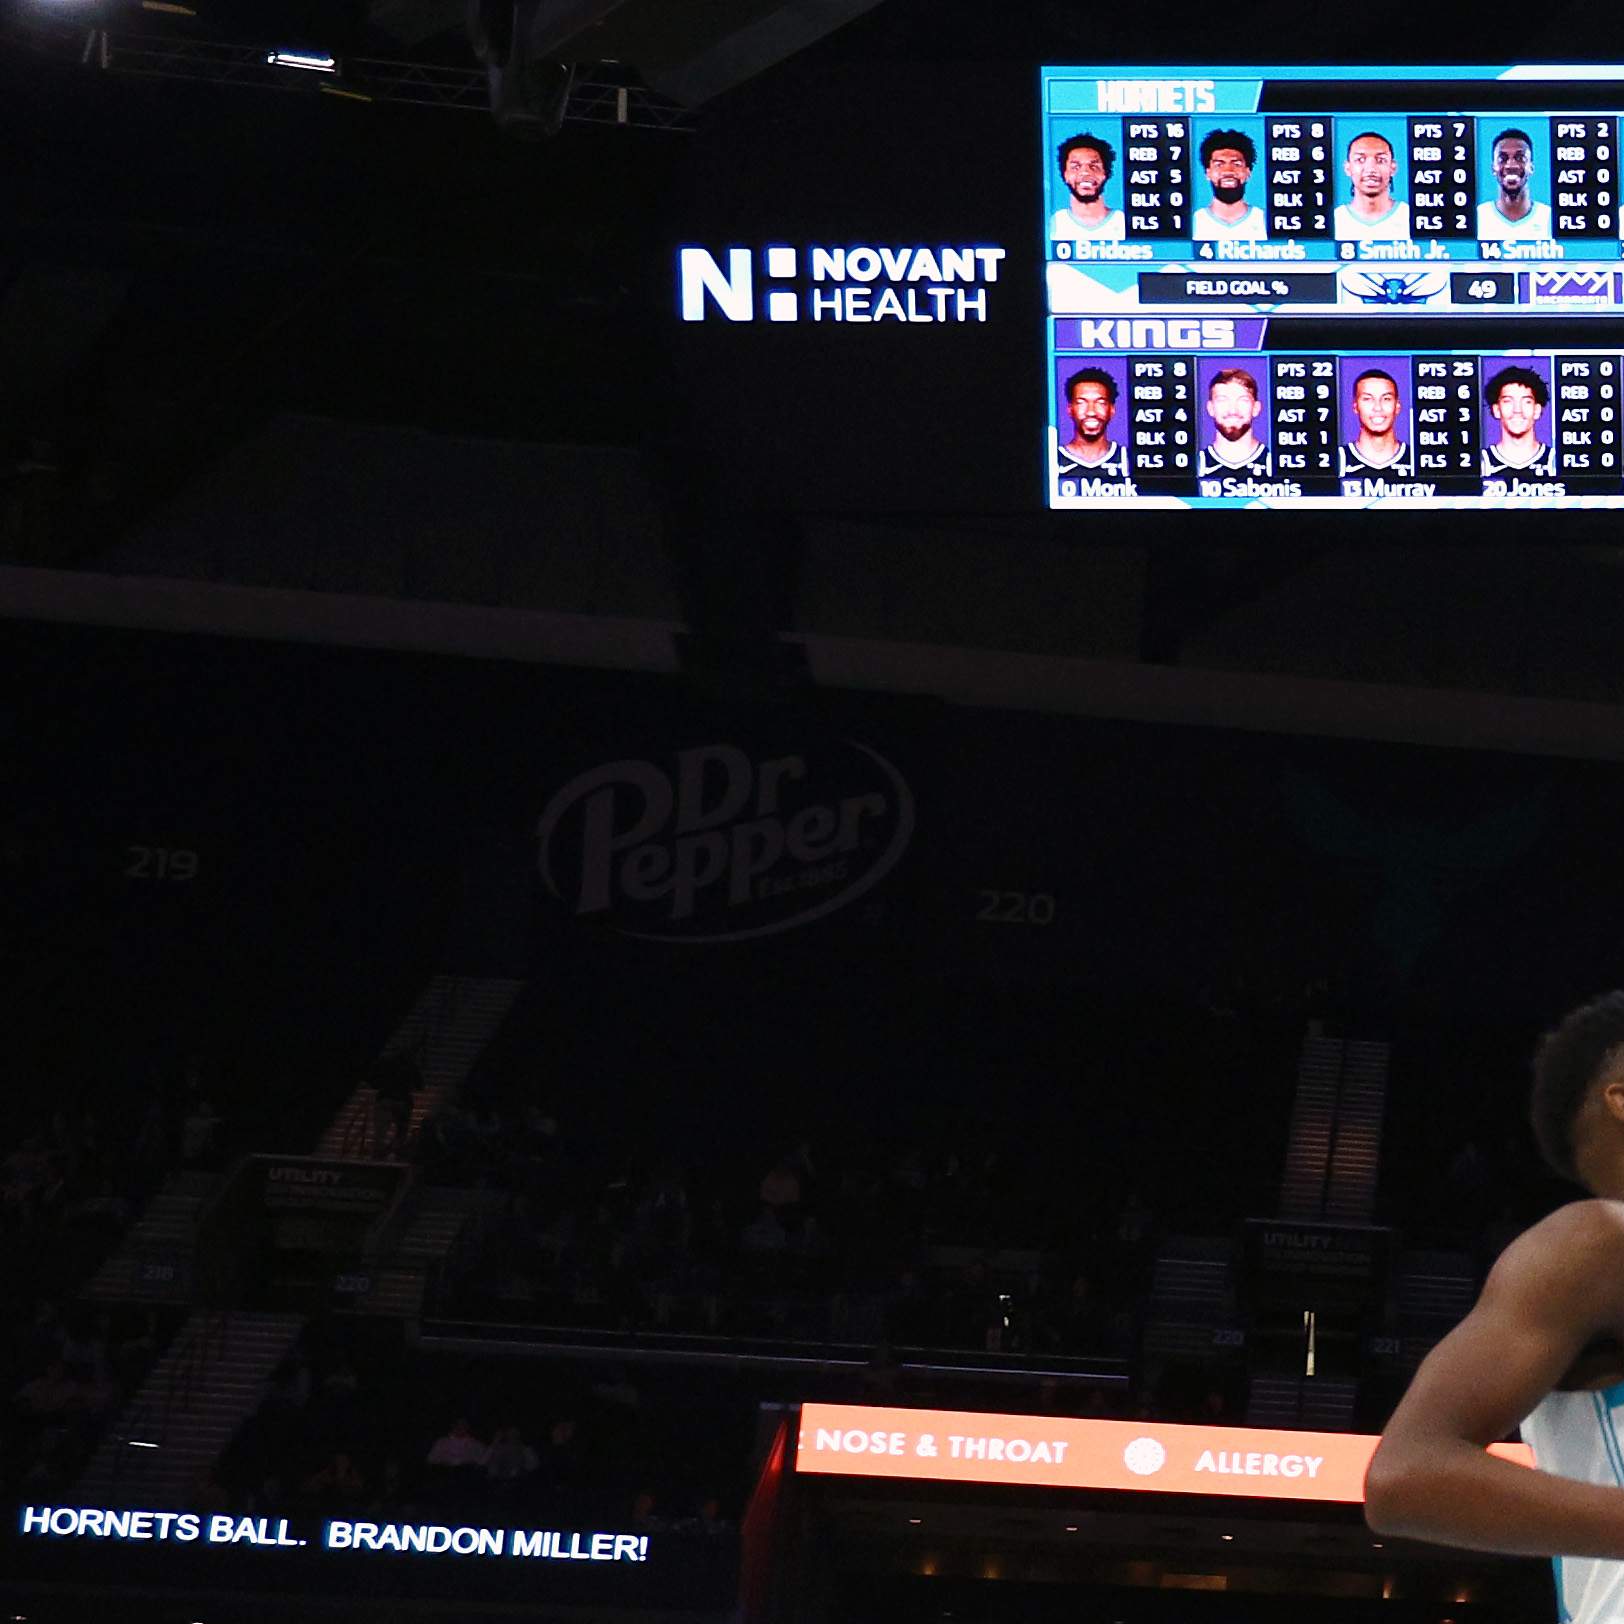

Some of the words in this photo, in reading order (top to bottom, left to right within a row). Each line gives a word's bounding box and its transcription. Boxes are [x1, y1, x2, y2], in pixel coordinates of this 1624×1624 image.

[1097, 81, 1215, 112] HORNETS
[1130, 125, 1158, 138] PTS
[1166, 124, 1184, 137] 16
[1130, 148, 1157, 161] REB
[1170, 147, 1181, 160] 7
[1131, 171, 1158, 184] AST
[1171, 170, 1181, 183] 5
[1132, 193, 1160, 207] BLK
[1170, 193, 1182, 206] 0
[1132, 216, 1158, 229] FLS
[1174, 215, 1180, 228] 1
[1057, 242, 1071, 259] 0
[1075, 240, 1153, 260] Bridges
[1200, 242, 1213, 259] 4
[1218, 240, 1306, 260] Richards
[1340, 242, 1354, 259] 8
[1359, 240, 1420, 260] Smith
[1424, 239, 1450, 259] Jr.
[1480, 244, 1501, 259] 14
[1503, 240, 1564, 259] Smith
[813, 247, 1005, 282] NOVANT
[1186, 281, 1228, 296] FIELD
[1230, 281, 1270, 296] GOAL
[1272, 281, 1289, 296] %
[1468, 280, 1497, 298] 49
[813, 288, 987, 322] HEALTH
[1080, 320, 1236, 348] KINGS
[1278, 364, 1305, 377] PTS
[1313, 362, 1333, 376] 22
[1277, 386, 1304, 399] REB
[1317, 385, 1329, 398] 9
[1278, 409, 1305, 422] AST
[1318, 408, 1328, 421] 7
[1061, 480, 1073, 497] 0
[1081, 478, 1138, 497] Monk
[1201, 481, 1221, 497] 10
[1223, 478, 1302, 497] Sabonis
[1343, 480, 1362, 497] 13
[1364, 478, 1436, 497] Murray
[1482, 481, 1507, 497] 20
[1507, 478, 1565, 497] Jones
[679, 743, 806, 830] Dr
[563, 760, 887, 918] Pepper
[126, 846, 198, 882] 219
[977, 890, 1055, 926] 220
[816, 1428, 905, 1457] NOSE
[915, 1434, 938, 1458] &
[949, 1437, 1068, 1465] THROAT
[1195, 1450, 1324, 1479] ALLERGY
[22, 1506, 200, 1541] HORNETS
[208, 1516, 308, 1546] BALL.
[327, 1521, 503, 1556] BRANDON
[511, 1530, 649, 1563] MILLER!
